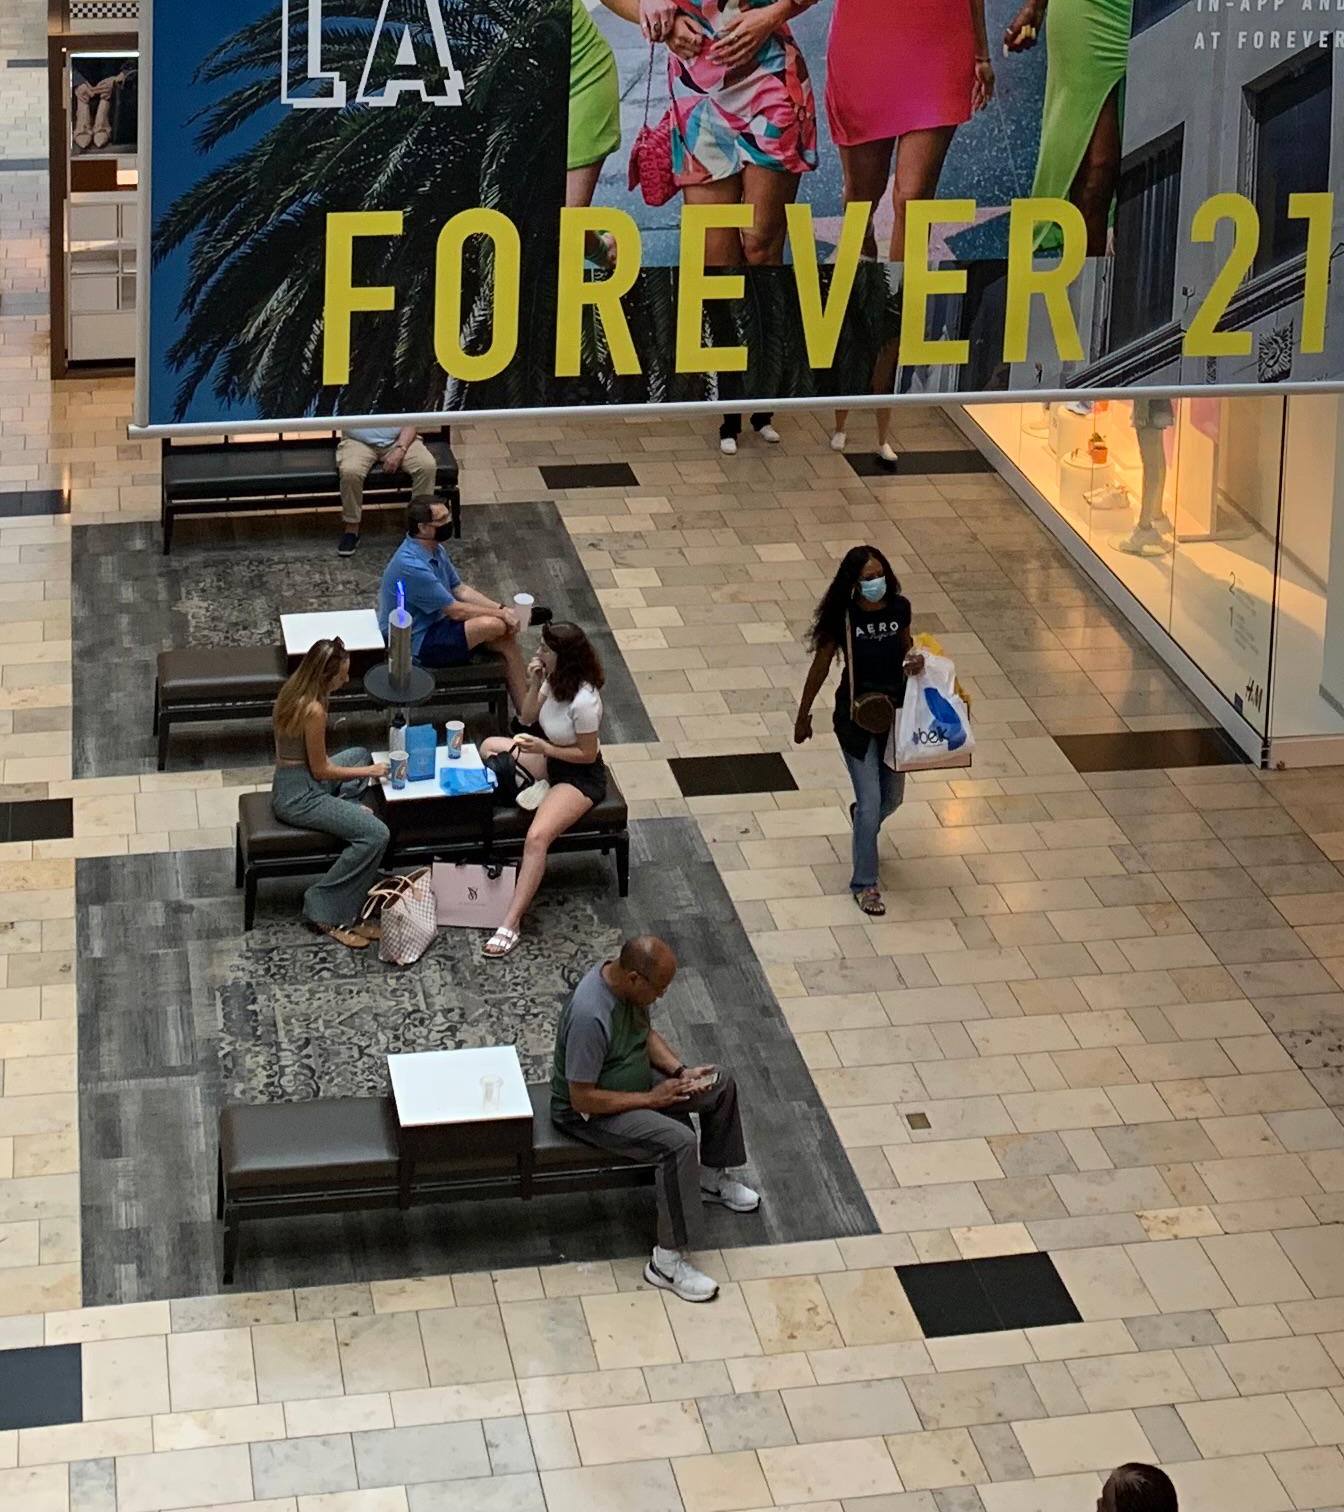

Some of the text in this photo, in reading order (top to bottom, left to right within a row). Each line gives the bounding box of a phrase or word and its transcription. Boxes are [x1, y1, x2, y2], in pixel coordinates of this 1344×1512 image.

[1194, 31, 1221, 50] AT
[321, 191, 1335, 388] FOREVER 21
[856, 621, 899, 637] AERO
[917, 726, 948, 745] belk
